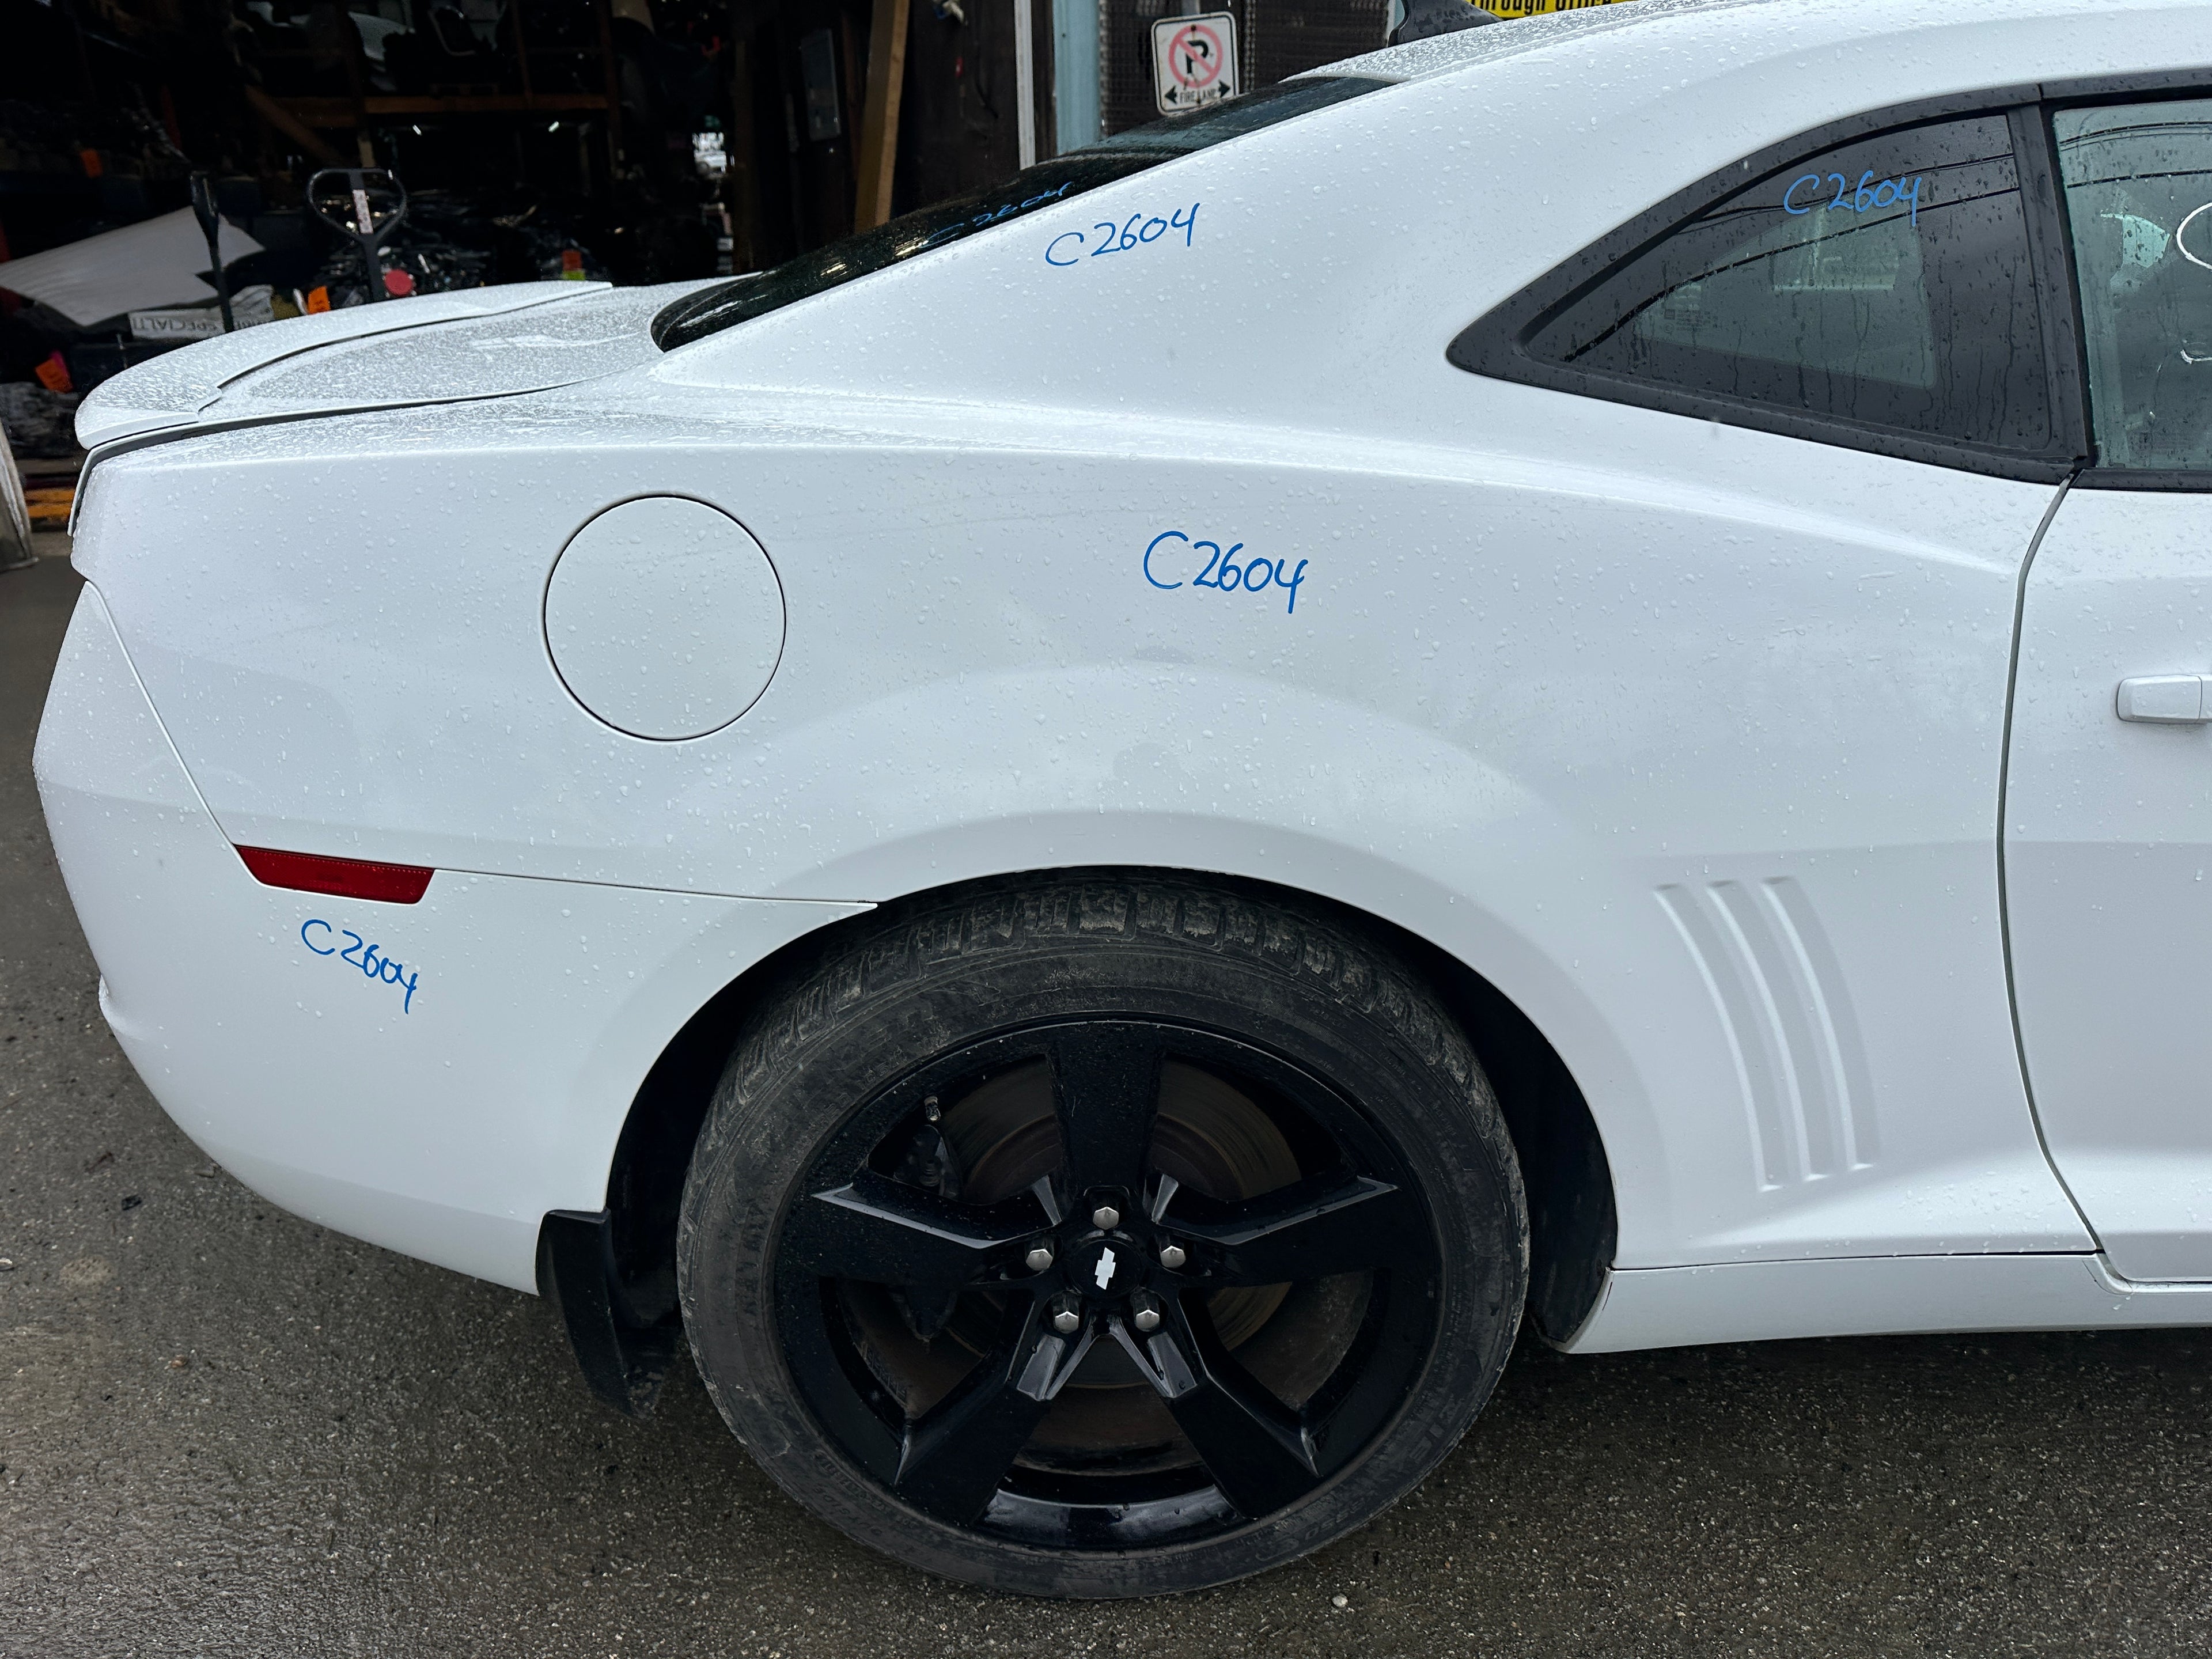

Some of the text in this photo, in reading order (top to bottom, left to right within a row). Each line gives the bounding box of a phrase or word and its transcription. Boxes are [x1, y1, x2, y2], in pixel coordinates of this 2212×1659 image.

[1179, 90, 1196, 104] FIRE
[1783, 169, 1922, 227] C2604
[1044, 202, 1200, 267] C2604
[1143, 531, 1309, 614] C2604
[301, 919, 418, 1014] C2604
